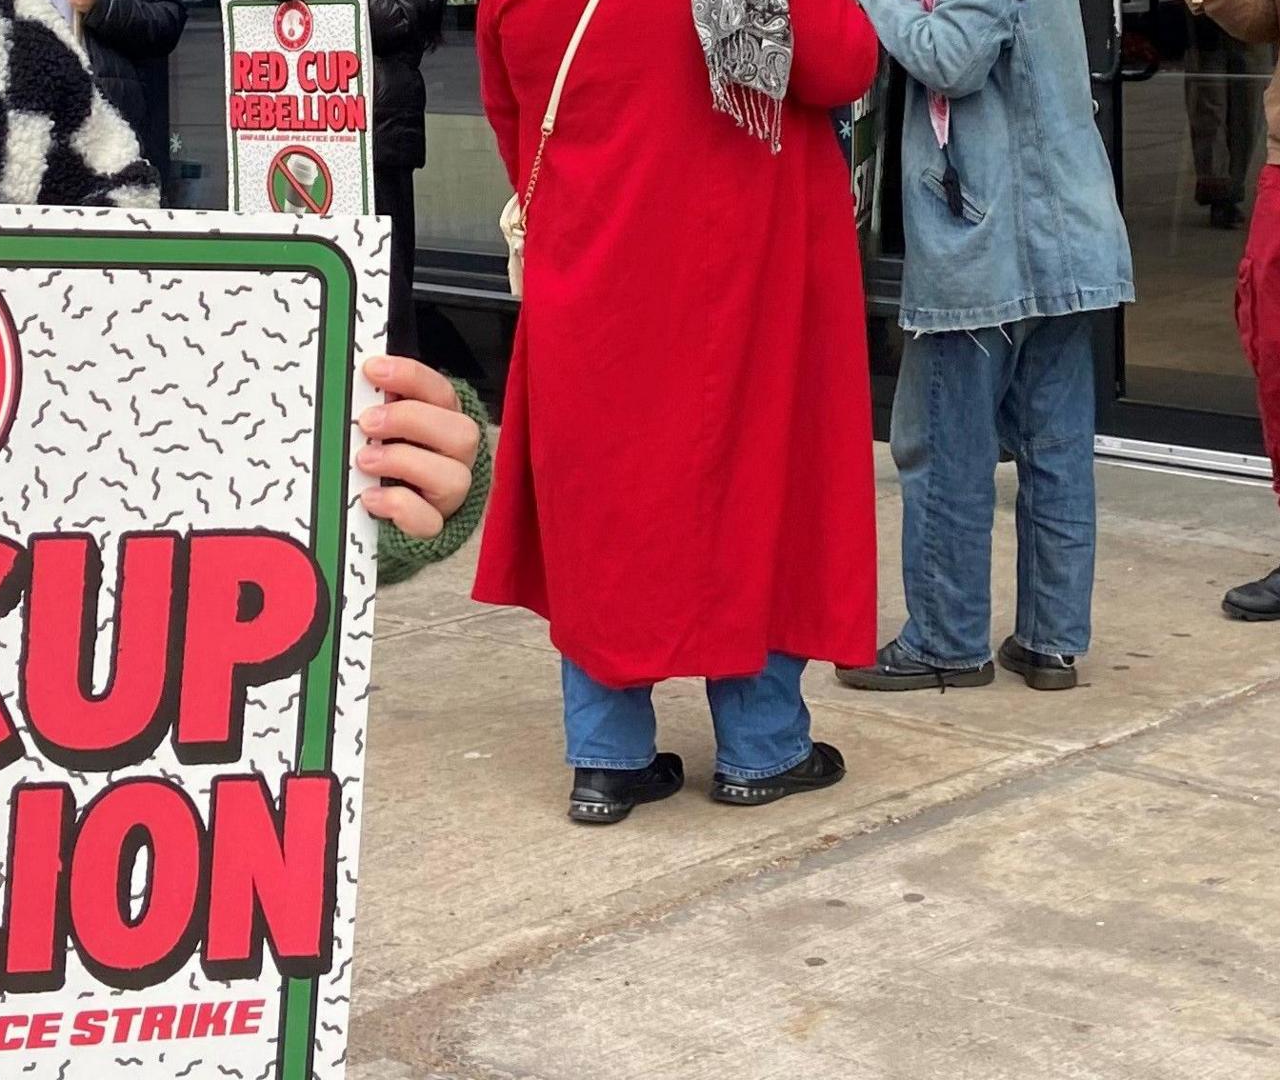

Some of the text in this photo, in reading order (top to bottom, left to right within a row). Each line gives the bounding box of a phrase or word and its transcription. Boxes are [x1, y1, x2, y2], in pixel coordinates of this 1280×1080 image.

[232, 50, 362, 93] RED CUP
[229, 94, 367, 132] REBELLION
[69, 999, 266, 1046] STRIKE
